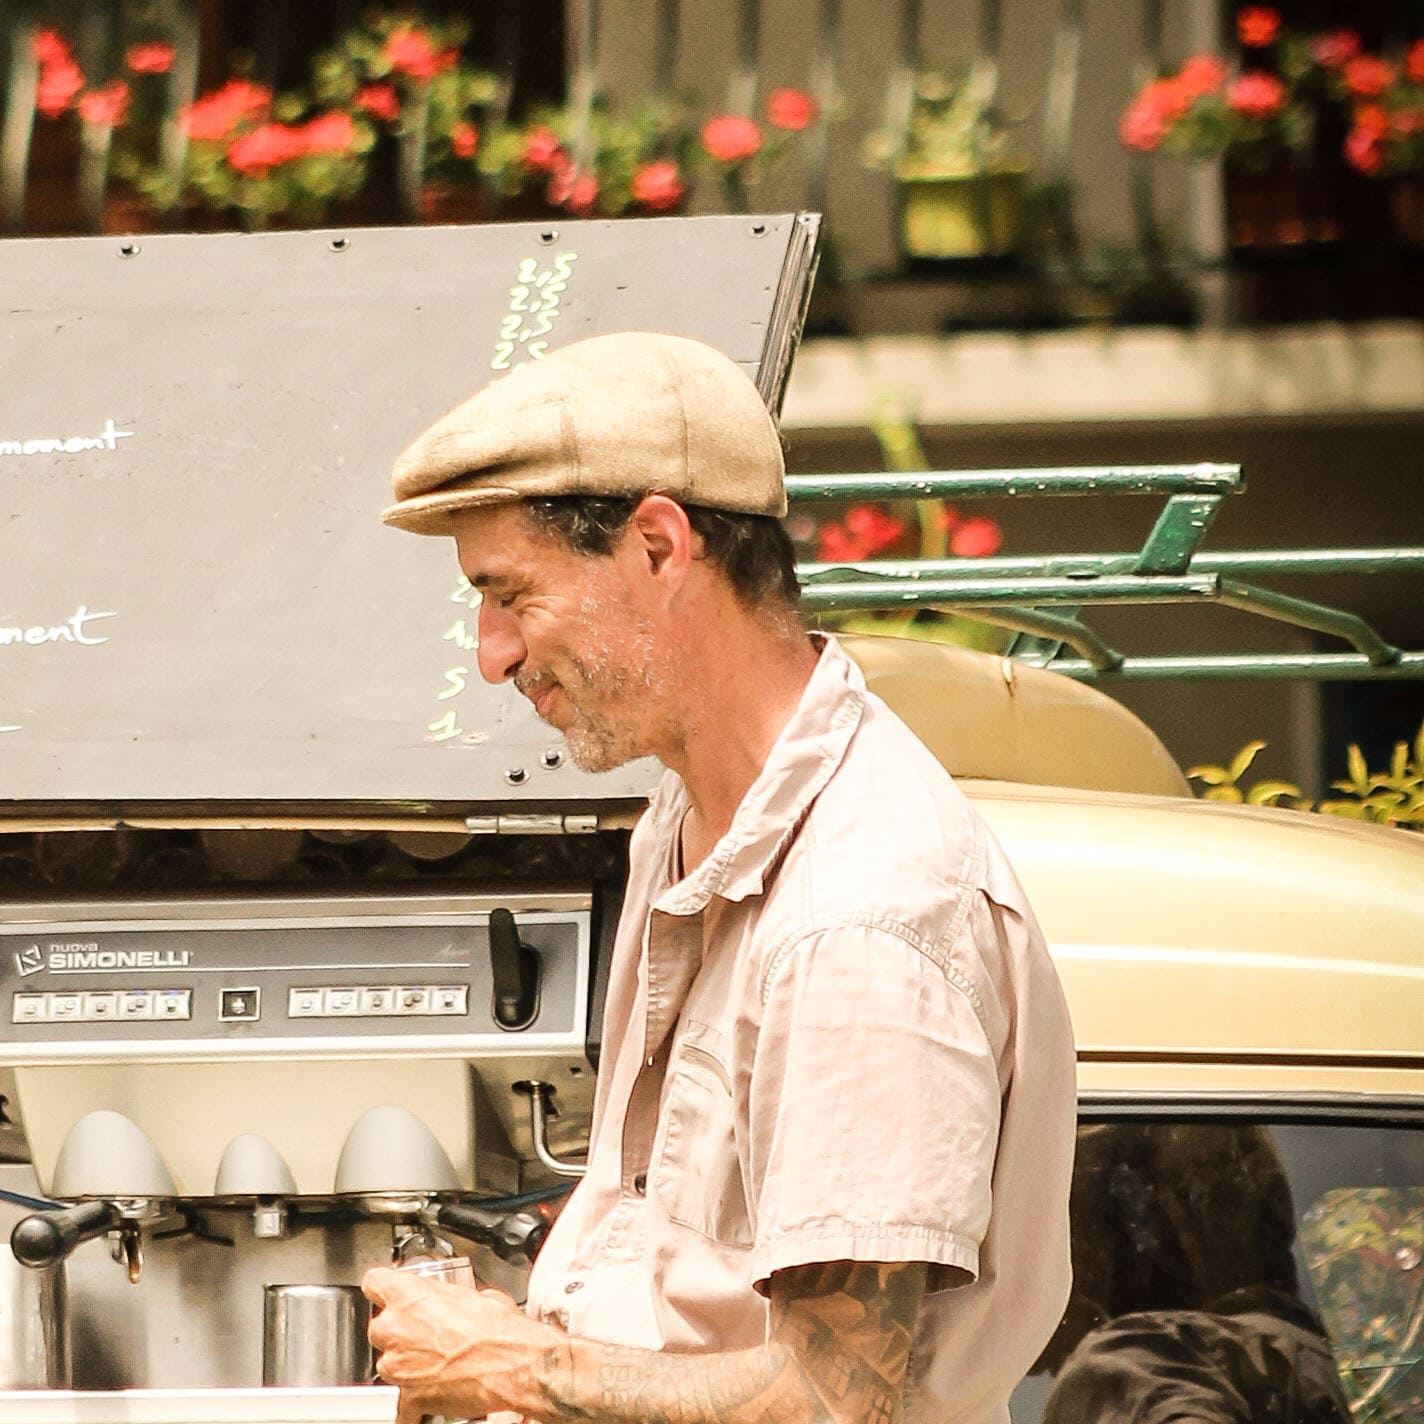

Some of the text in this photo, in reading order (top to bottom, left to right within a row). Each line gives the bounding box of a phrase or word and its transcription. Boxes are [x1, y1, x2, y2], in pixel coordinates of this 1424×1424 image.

[518, 252, 579, 288] 2,5
[509, 281, 567, 313] 2,5
[500, 309, 560, 343] 2,5
[450, 575, 484, 609] 2,
[437, 666, 469, 702] 5
[427, 710, 463, 741] 1
[49, 950, 189, 969] SIMONELLI
[50, 942, 99, 953] nuova
